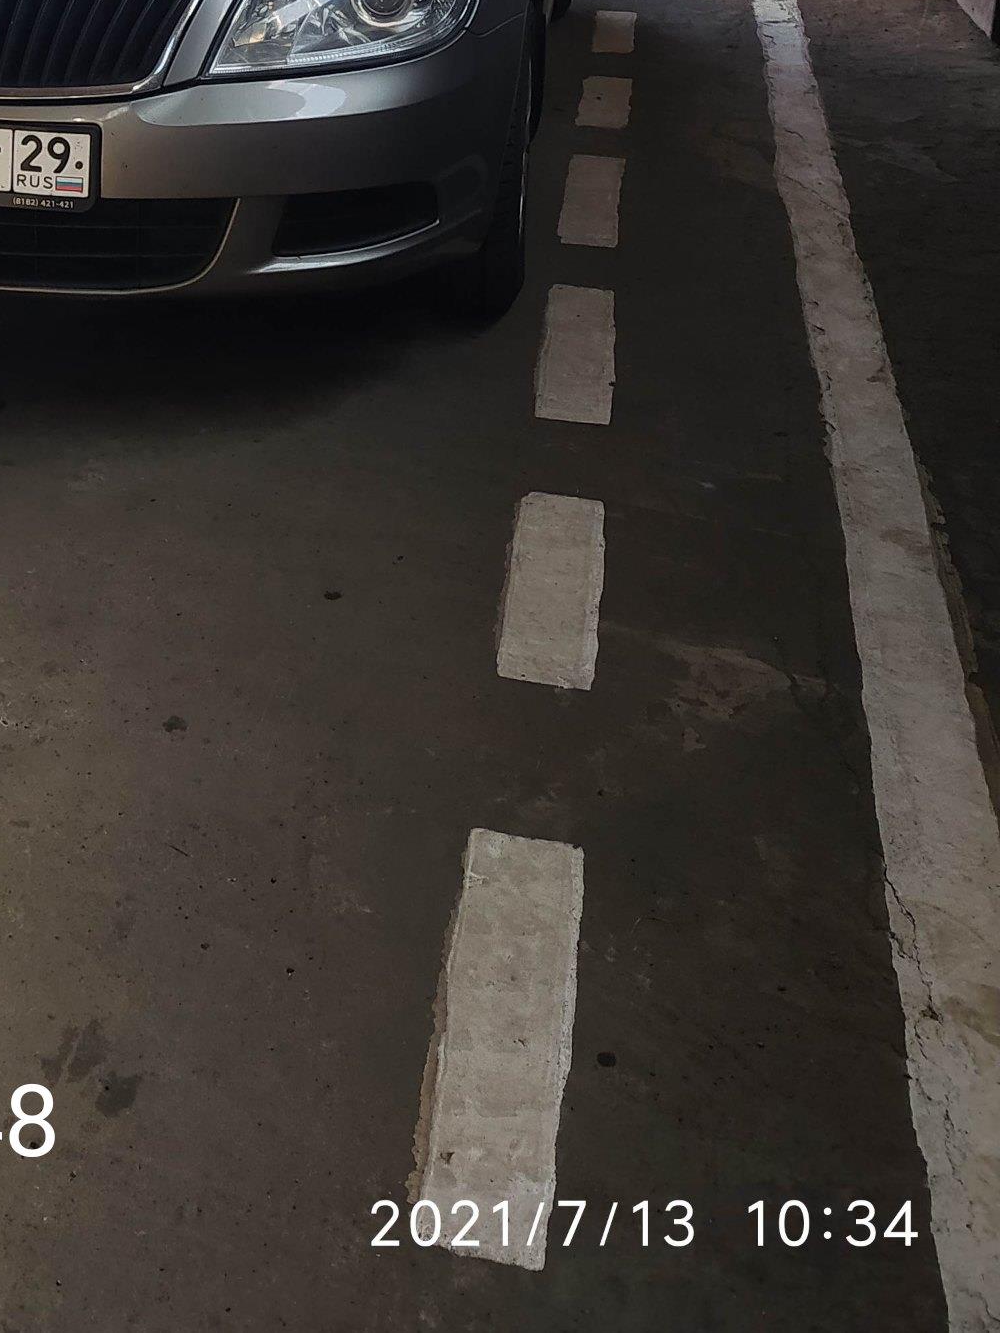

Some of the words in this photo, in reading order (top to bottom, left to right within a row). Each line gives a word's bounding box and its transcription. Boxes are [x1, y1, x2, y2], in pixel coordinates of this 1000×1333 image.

[19, 134, 71, 174] 29
[16, 173, 54, 190] RUS
[40, 199, 74, 209] 421-421
